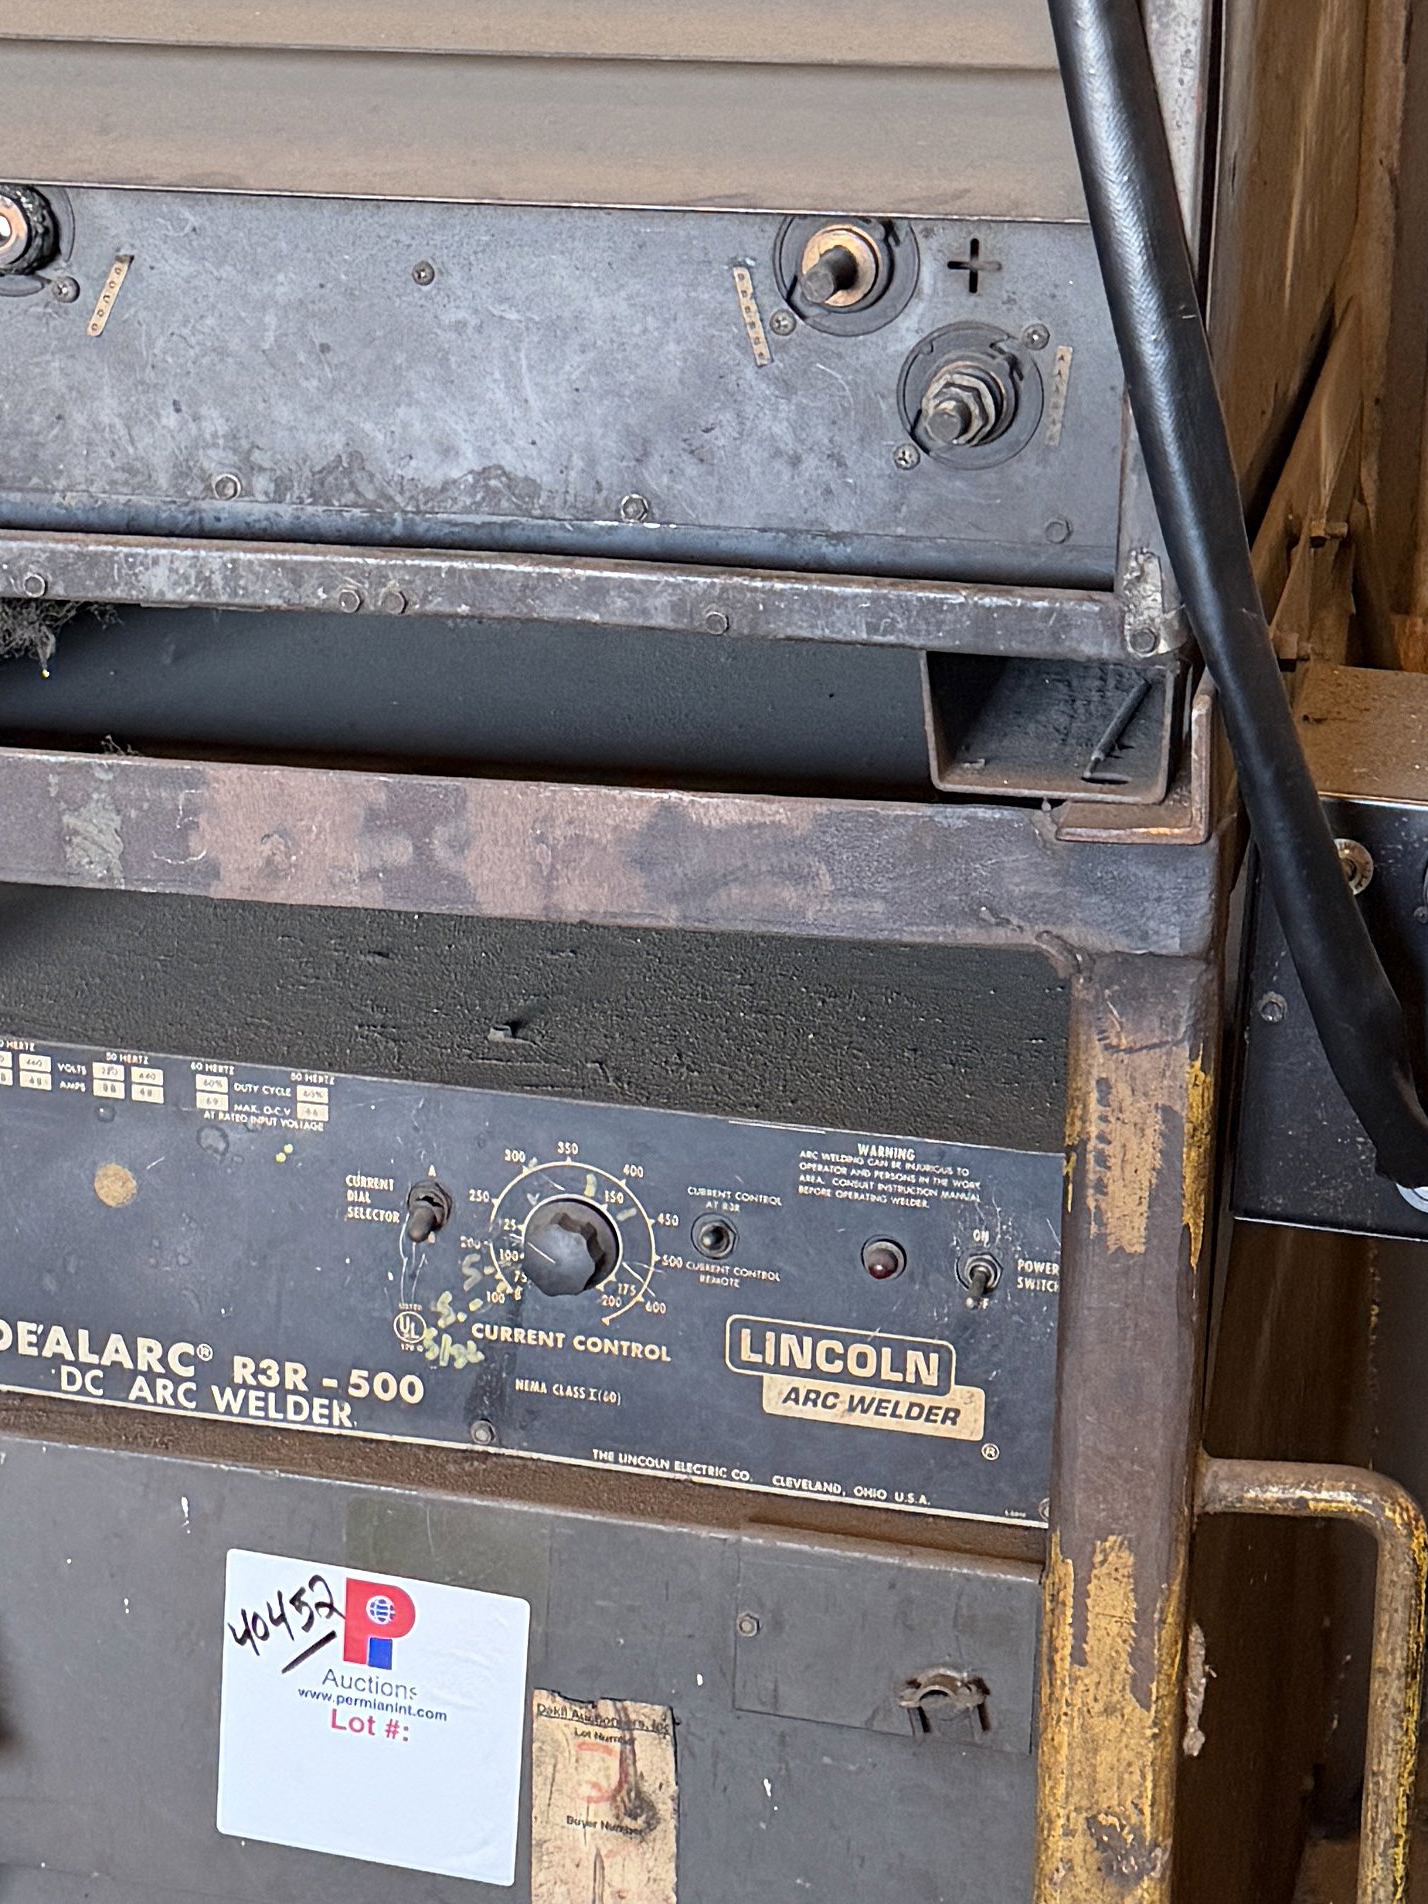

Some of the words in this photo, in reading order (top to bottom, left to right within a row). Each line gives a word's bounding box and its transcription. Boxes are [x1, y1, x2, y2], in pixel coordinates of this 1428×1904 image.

[57, 1062, 87, 1076] VOLTS
[60, 1080, 86, 1092] AMPS
[234, 1082, 259, 1093] DUTY
[262, 1085, 292, 1097] CYCLE
[203, 1110, 215, 1121] AT
[218, 1112, 248, 1124] RATED
[250, 1115, 277, 1127] INPUT
[281, 1118, 324, 1132] VOLTAGE
[504, 1149, 526, 1163] 300
[557, 1141, 579, 1155] 350
[858, 1142, 916, 1162] WARNING
[623, 1163, 645, 1178] 400
[799, 1149, 819, 1162] ARC
[821, 1152, 864, 1166] WELDING
[867, 1157, 889, 1169] CAN
[905, 1163, 954, 1176] INJURIOUS
[957, 1166, 970, 1177] TO
[345, 1173, 395, 1192] CURRENT
[799, 1161, 848, 1176] OPERATOR
[850, 1167, 872, 1179] AND
[874, 1171, 917, 1185] PERSONS
[933, 1177, 948, 1188] THE
[953, 1179, 981, 1191] WORK
[347, 1189, 372, 1204] DIAL
[468, 1188, 491, 1204] 250
[603, 1189, 625, 1205] 150
[687, 1186, 732, 1200] CURRENT
[735, 1191, 783, 1207] CONTROL
[798, 1185, 832, 1198] BEFORE
[835, 1189, 888, 1204] OPERATING
[799, 1173, 825, 1186] AREA.
[832, 1177, 875, 1192] CONSULT
[878, 1183, 938, 1198] INSTRUCTION
[940, 1189, 981, 1204] MANUAL
[705, 1200, 719, 1210] AT
[347, 1206, 401, 1224] SELECTOR
[657, 1212, 680, 1228] 450
[662, 1254, 684, 1269] 500
[686, 1260, 730, 1275] CURRENT
[733, 1267, 781, 1282] CONTROL
[1017, 1258, 1060, 1277] POWER
[617, 1282, 637, 1297] 175
[699, 1273, 741, 1288] REMOTE
[486, 1290, 506, 1304] 100
[601, 1294, 623, 1308] 200
[645, 1300, 667, 1315] 600
[471, 1322, 566, 1349] CURRENT
[572, 1335, 672, 1363] CONTROL
[740, 1328, 940, 1387] LINCOLN
[60, 1364, 104, 1397] DC
[127, 1375, 197, 1409] ARC
[233, 1355, 309, 1392] R3R
[347, 1368, 425, 1405] 500
[515, 1378, 548, 1395] NEMA
[551, 1383, 586, 1401] CLASS
[781, 1386, 841, 1411] ARC
[847, 1394, 962, 1427] WELDER
[592, 1448, 615, 1463] THE
[618, 1453, 670, 1471] LINCOLN
[674, 1460, 728, 1479] ELECTRIC
[731, 1468, 754, 1483] CO.
[772, 1475, 847, 1498] CLEVELAND,
[853, 1485, 888, 1502] OHIO
[894, 1491, 932, 1507] U.S.A.
[227, 1573, 346, 1657] 40452
[322, 1668, 418, 1701] Auctions
[298, 1687, 448, 1723] www.permianint.com
[331, 1707, 376, 1736] Lot
[574, 1728, 592, 1740] Lot
[567, 1815, 597, 1829] Buyer
